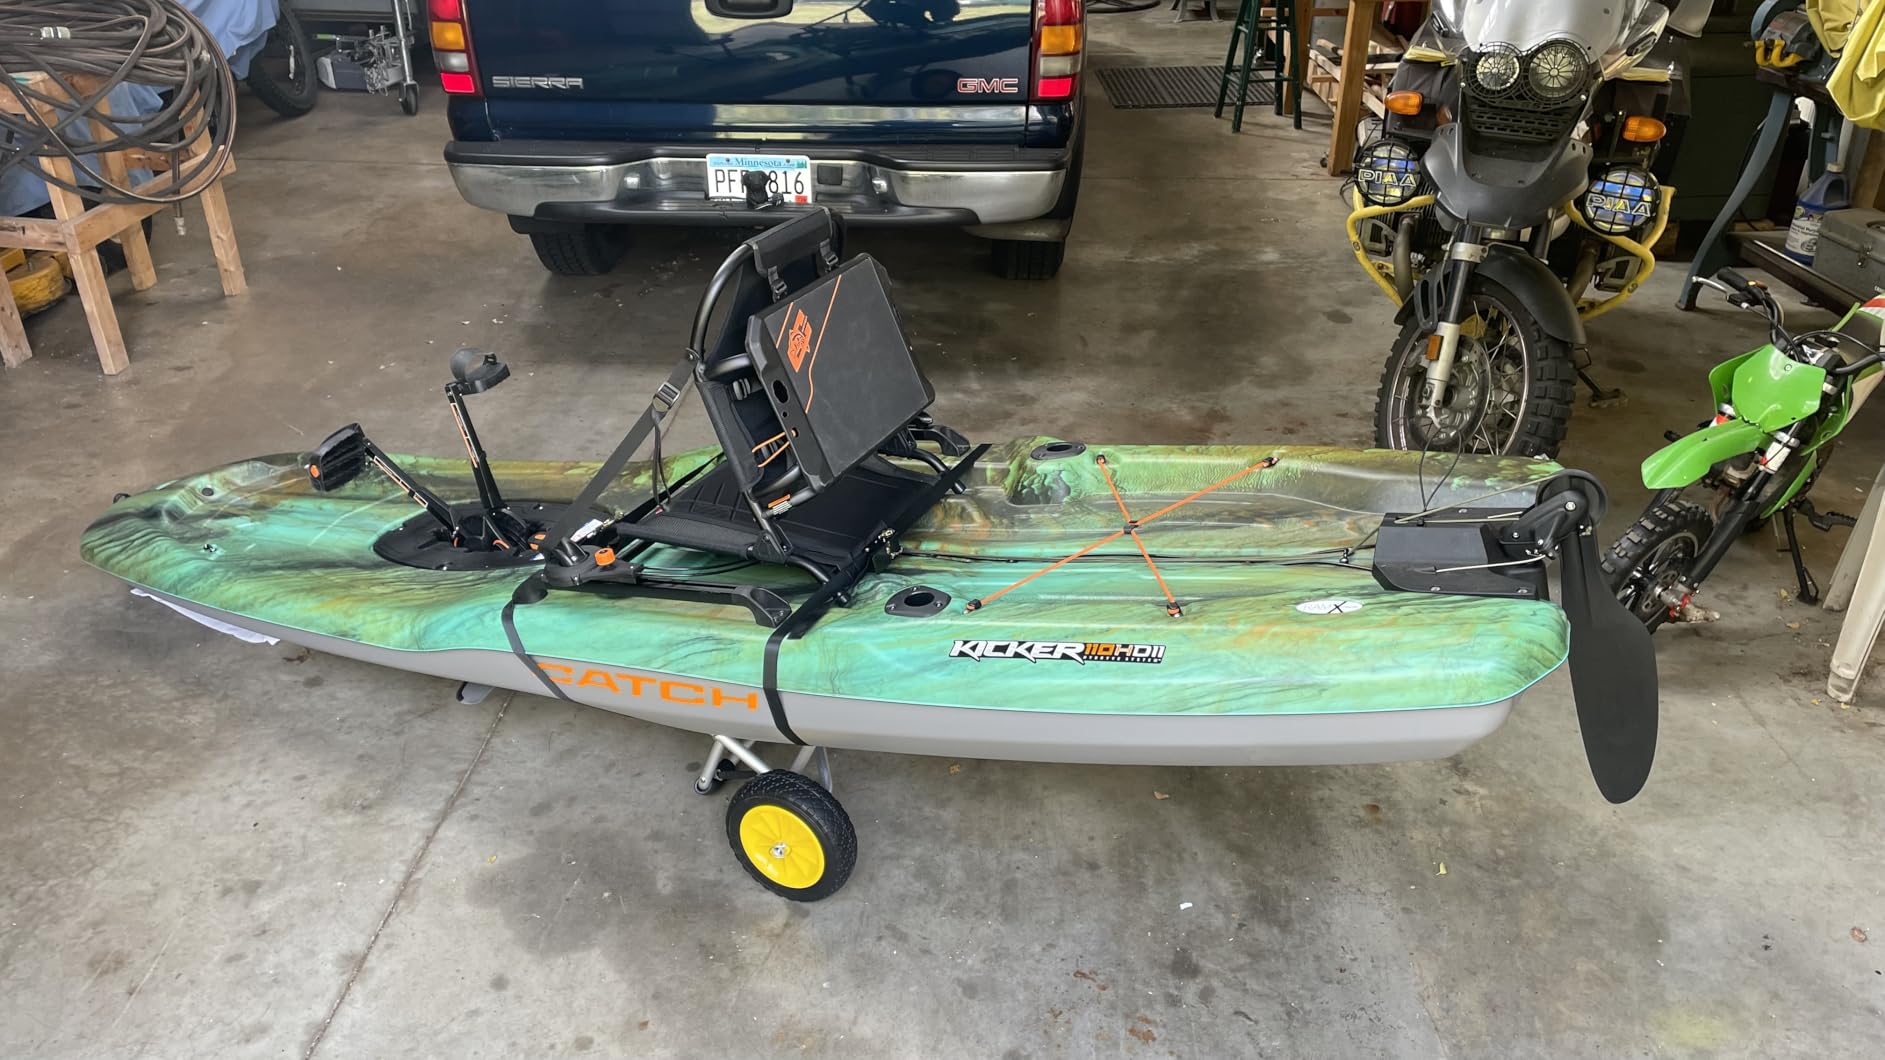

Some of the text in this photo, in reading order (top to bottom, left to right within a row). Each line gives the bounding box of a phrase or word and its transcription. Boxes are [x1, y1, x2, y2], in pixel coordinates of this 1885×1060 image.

[491, 76, 584, 89] SIERRA
[957, 78, 1019, 93] GMC
[735, 157, 782, 167] Minnesota
[768, 170, 804, 195] 816
[1358, 169, 1417, 187] PIAA
[1586, 193, 1651, 217] PIAA
[949, 640, 1086, 665] KICKER
